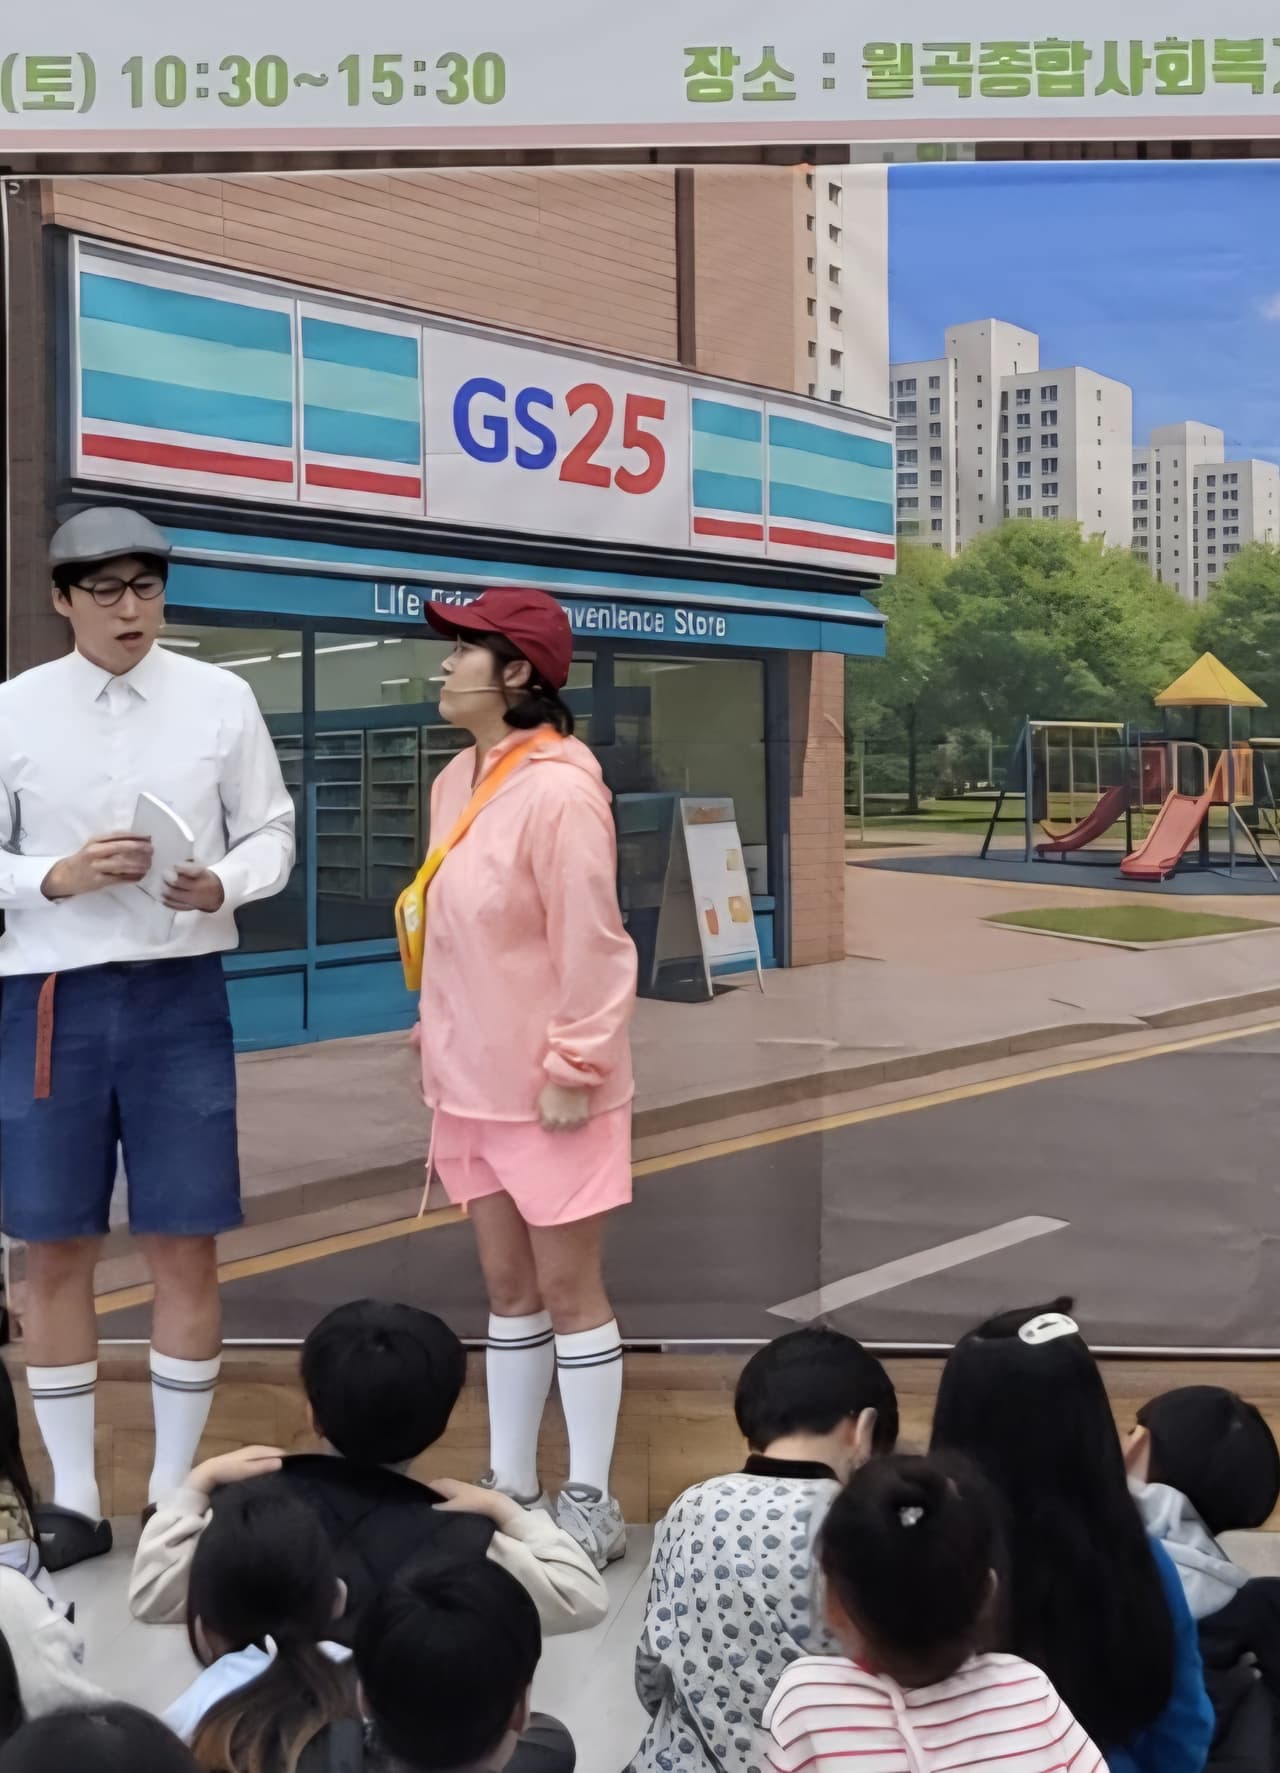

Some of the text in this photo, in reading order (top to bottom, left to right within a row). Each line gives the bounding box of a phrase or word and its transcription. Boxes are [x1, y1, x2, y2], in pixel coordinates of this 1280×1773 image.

[121, 52, 506, 109] 10:30~15:30
[683, 46, 796, 102] 장소
[453, 377, 666, 494] GS25
